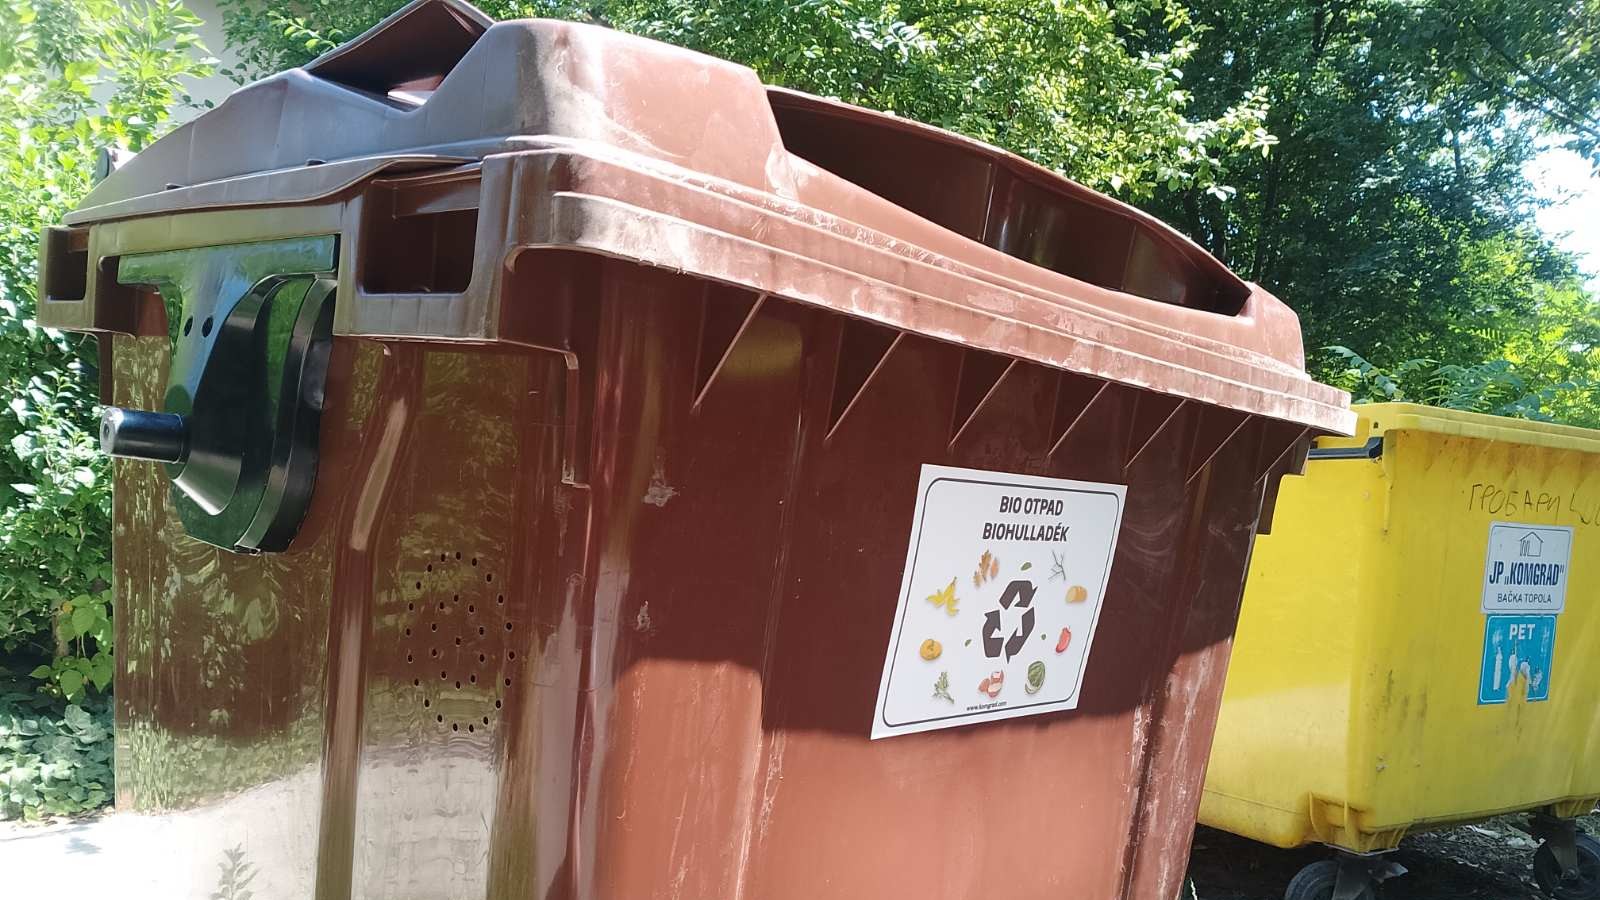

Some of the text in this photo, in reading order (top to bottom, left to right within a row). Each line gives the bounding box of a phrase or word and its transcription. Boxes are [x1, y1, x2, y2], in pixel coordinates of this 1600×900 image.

[999, 496, 1063, 516] BIO OTPAD
[982, 522, 1069, 542] BIOHULLADÉK
[1489, 560, 1504, 585] JP
[1497, 590, 1552, 604] BAČKA TOPOLA
[1509, 623, 1535, 640] PET
